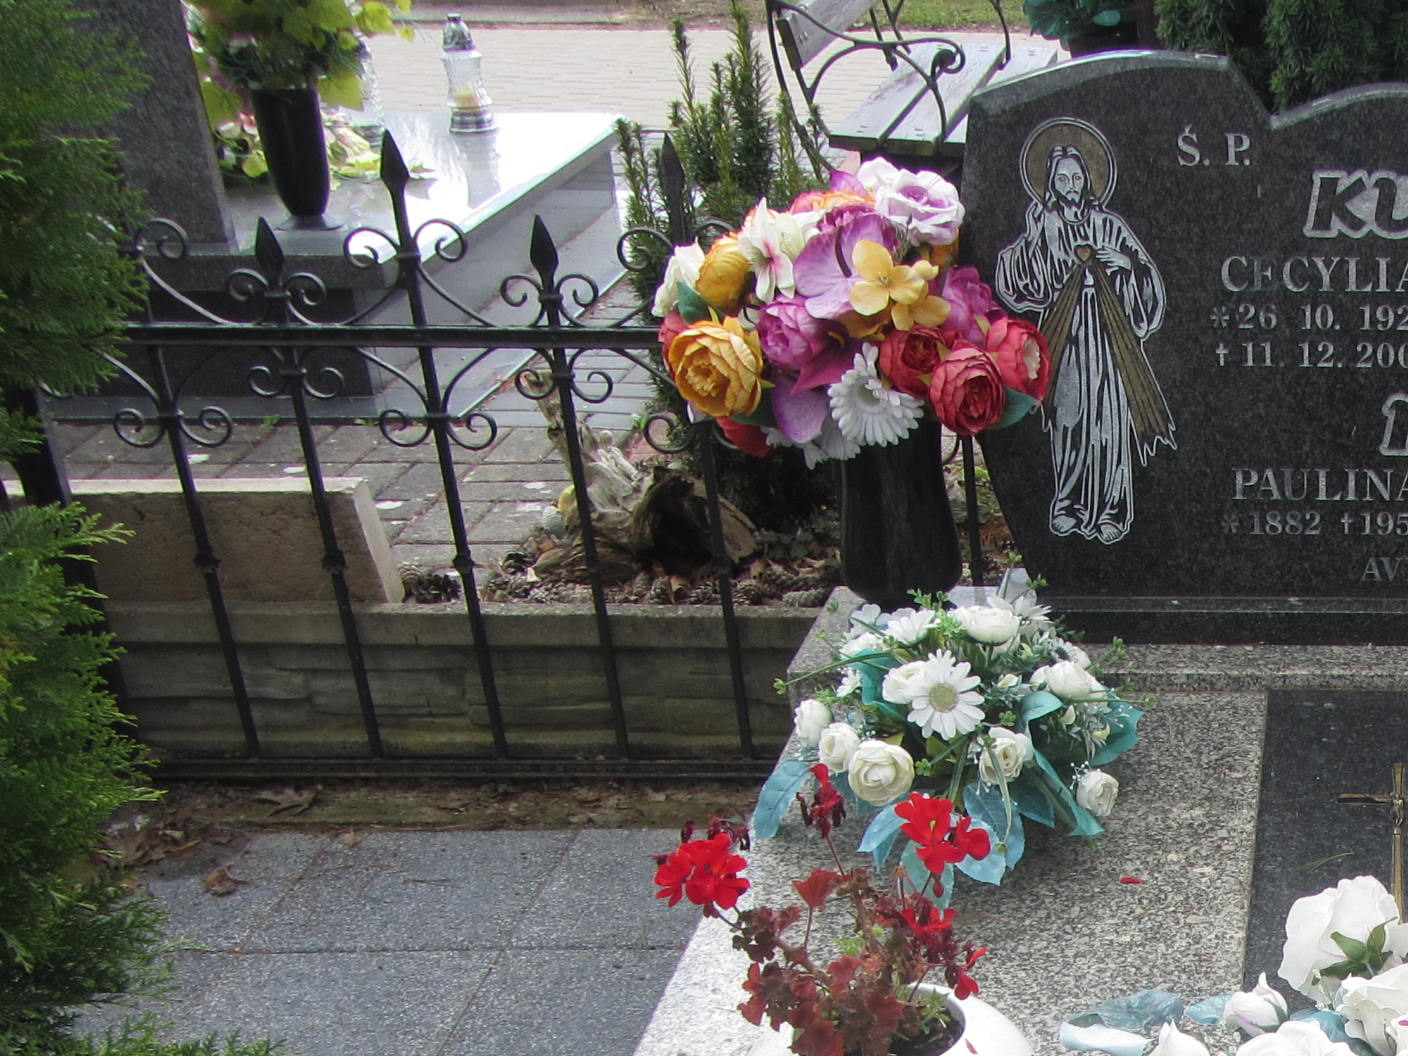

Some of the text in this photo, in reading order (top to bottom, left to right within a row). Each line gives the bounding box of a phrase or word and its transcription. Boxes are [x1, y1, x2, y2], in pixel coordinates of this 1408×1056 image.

[1177, 124, 1251, 166] Ś. P.
[1300, 304, 1341, 330] 10.
[1298, 341, 1343, 368] 12.
[1250, 511, 1321, 535] 1882
